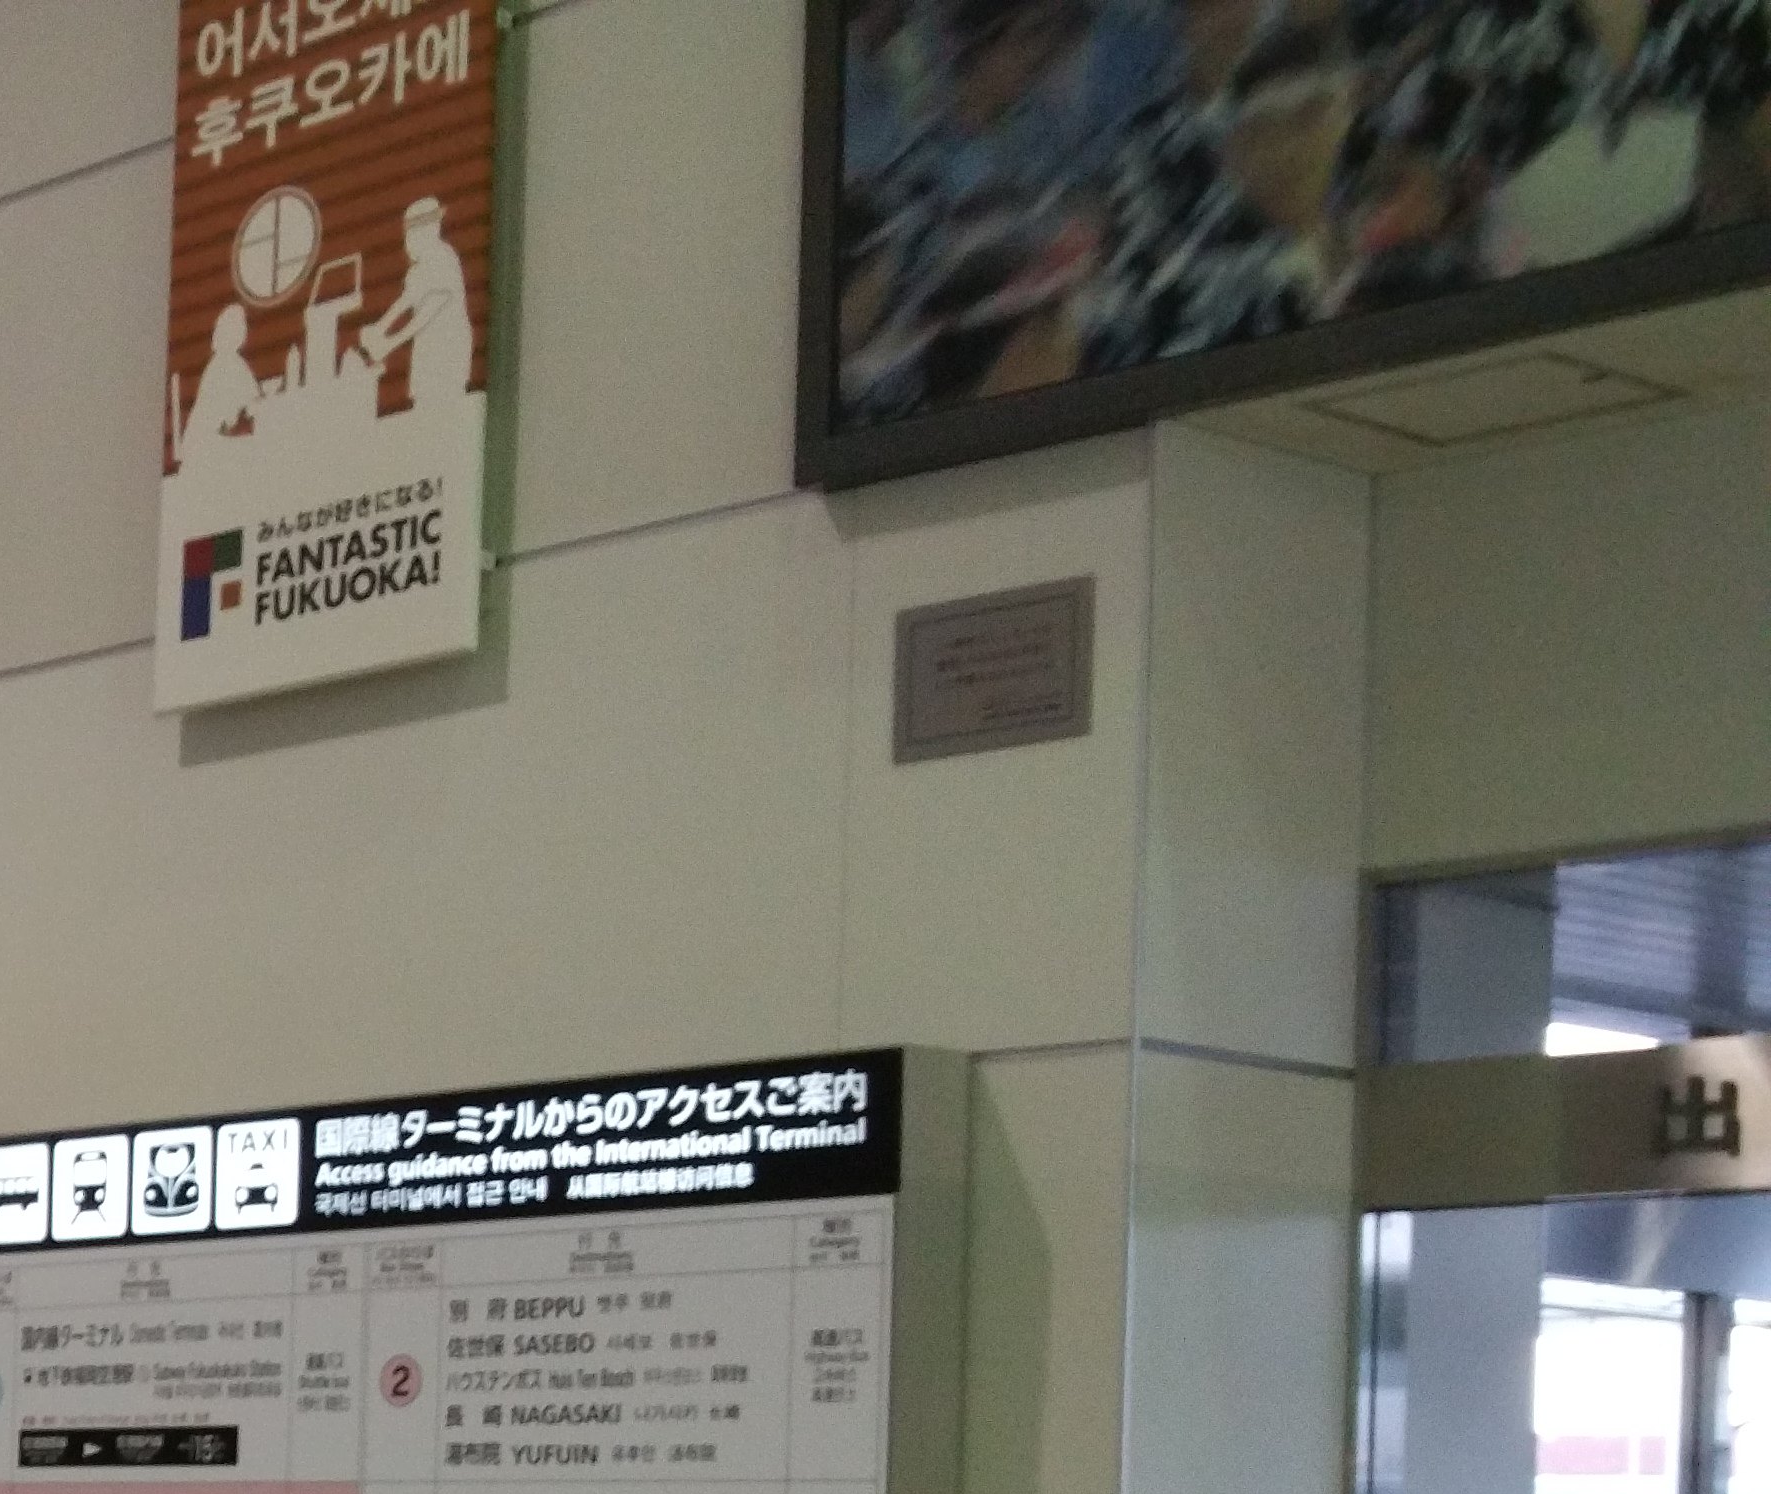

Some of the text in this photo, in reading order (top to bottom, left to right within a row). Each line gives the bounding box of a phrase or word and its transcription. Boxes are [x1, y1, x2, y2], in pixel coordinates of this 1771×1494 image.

[192, 10, 470, 166] 후쿠오카에
[257, 508, 441, 587] FANTASTIC
[255, 550, 441, 626] FUKUOKA!
[315, 1068, 868, 1158] 国際線ターミナルからのアクセスご案内
[228, 1128, 288, 1154] TAXI
[315, 1116, 868, 1187] Access guidance from the International Terminal
[513, 1296, 587, 1321] BEPPU
[514, 1331, 595, 1355] SASEBO
[391, 1365, 409, 1397] 2
[510, 1402, 623, 1426] NAGASAKI
[511, 1443, 601, 1467] YUFUIN
